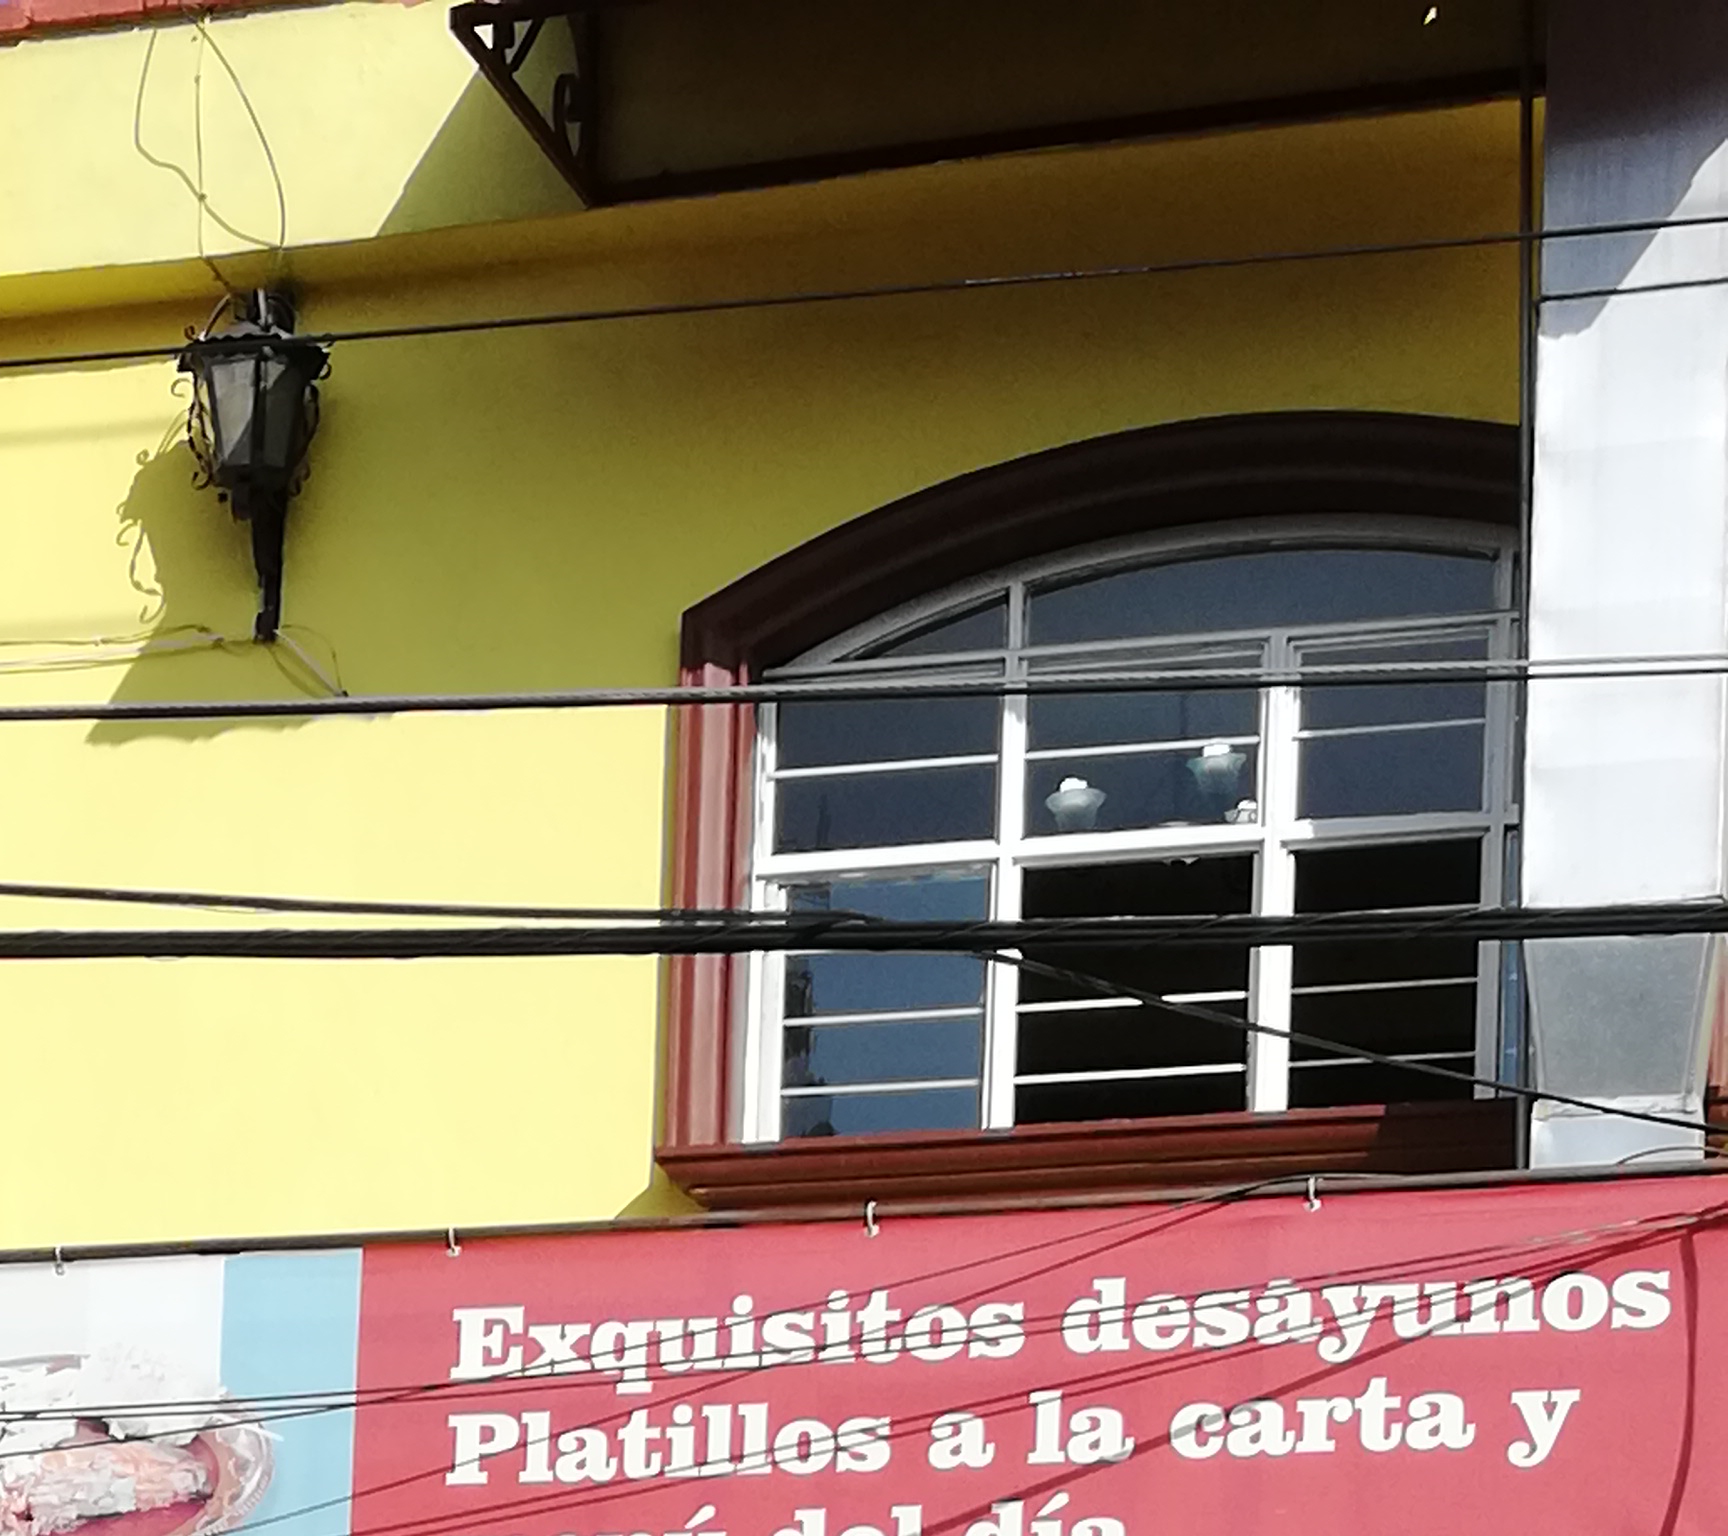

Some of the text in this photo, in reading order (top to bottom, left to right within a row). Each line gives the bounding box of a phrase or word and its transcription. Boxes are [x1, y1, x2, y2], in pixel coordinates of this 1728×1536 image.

[449, 1268, 1672, 1395] Exquisitos desayunos
[444, 1376, 1582, 1487] Platillos a la carta y
